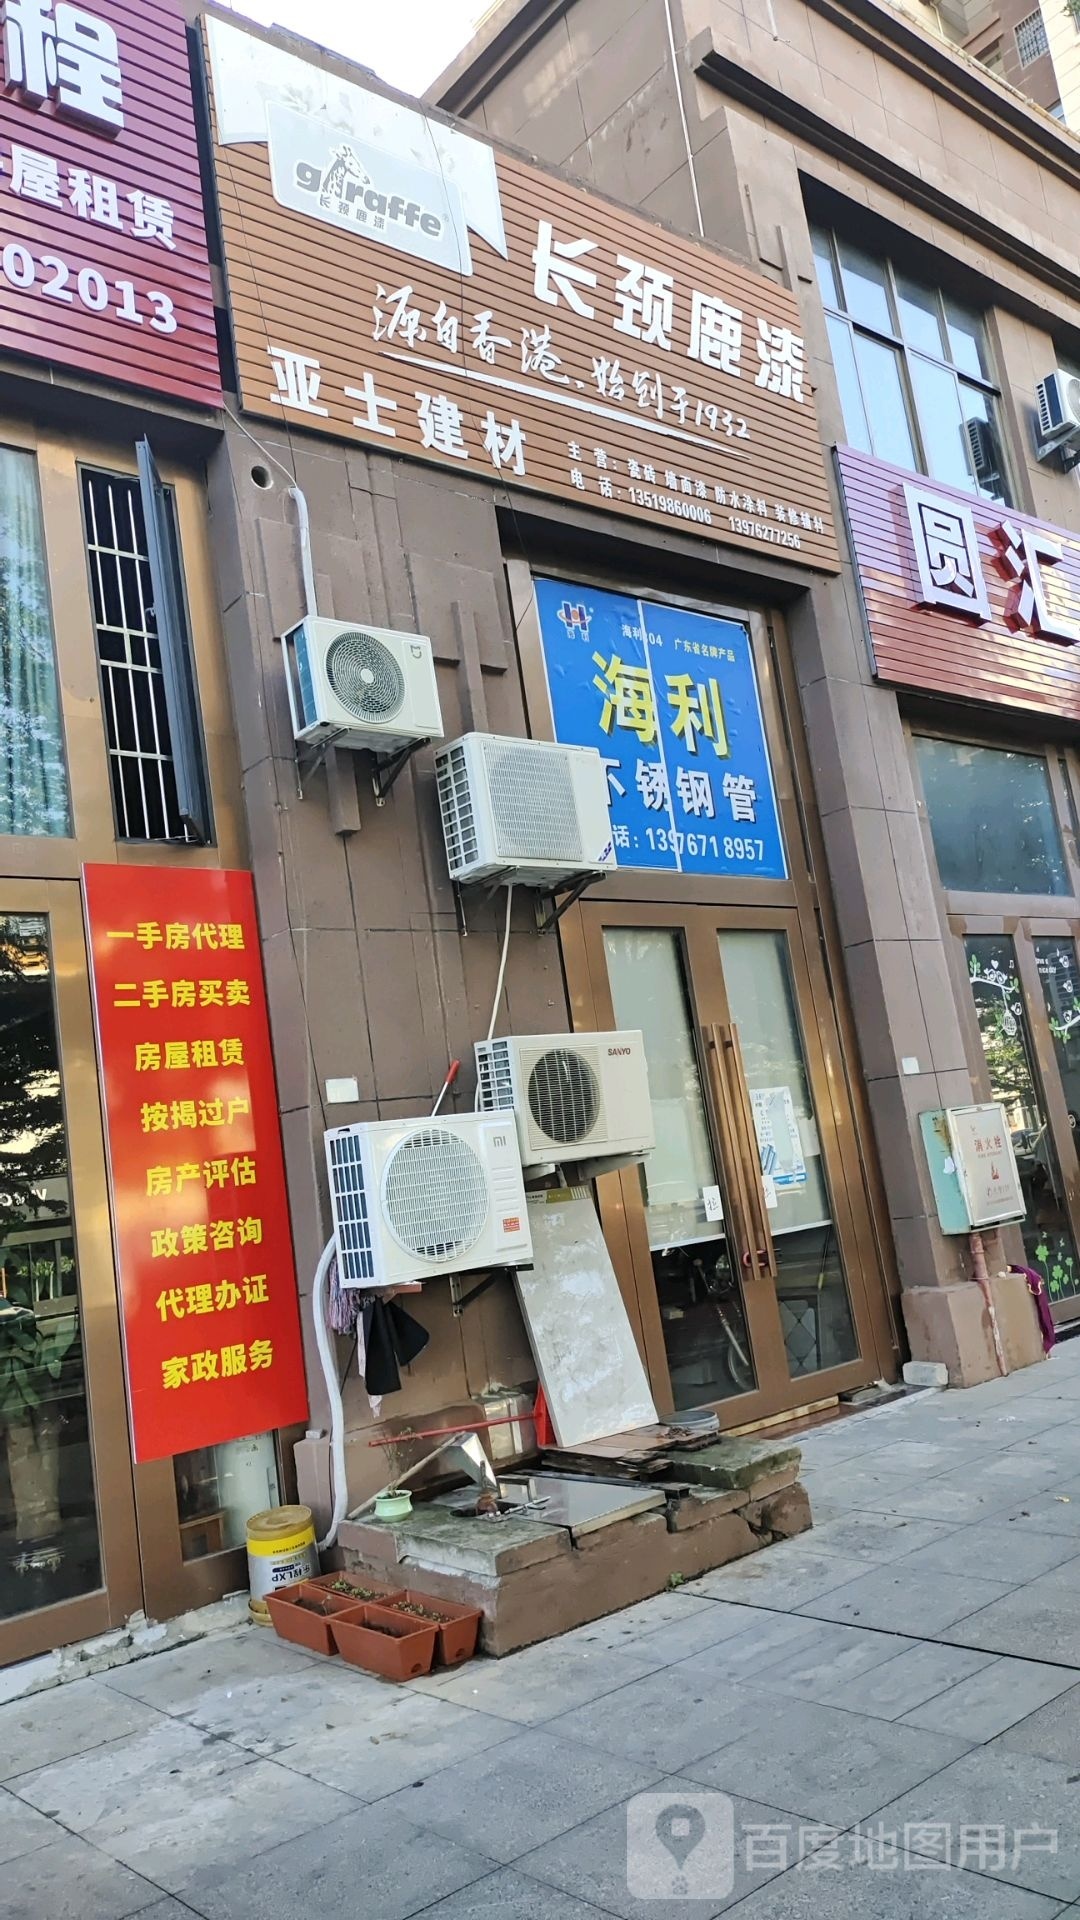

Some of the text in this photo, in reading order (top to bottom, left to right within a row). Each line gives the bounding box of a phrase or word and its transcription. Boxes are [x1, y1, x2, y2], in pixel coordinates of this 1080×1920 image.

[4, 0, 125, 129] 程
[0, 143, 177, 250] 屋租赁
[320, 193, 385, 230] 长颈鹿漆
[2, 243, 177, 334] 02013
[532, 219, 804, 403] 长颈鹿漆
[267, 344, 526, 476] 亚士建材
[664, 469, 707, 498] 墙面漆
[714, 485, 768, 518] 防水涂料
[628, 487, 712, 525] 13519860006
[728, 516, 801, 549] 13976277256
[903, 482, 1080, 645] 圆汇
[674, 638, 736, 662] 广东省名牌产品
[592, 651, 730, 757] 海利
[106, 922, 245, 950] 一手房代理
[114, 979, 250, 1008] 二手房买卖
[135, 1038, 244, 1071] 房屋租赁
[607, 1047, 631, 1056] SANYO
[140, 1097, 249, 1132] 按揭过户
[146, 1156, 256, 1196] 房产评估
[151, 1216, 262, 1258] 政策咨询
[155, 1274, 269, 1322] 代理办证
[161, 1340, 274, 1390] 家政服务
